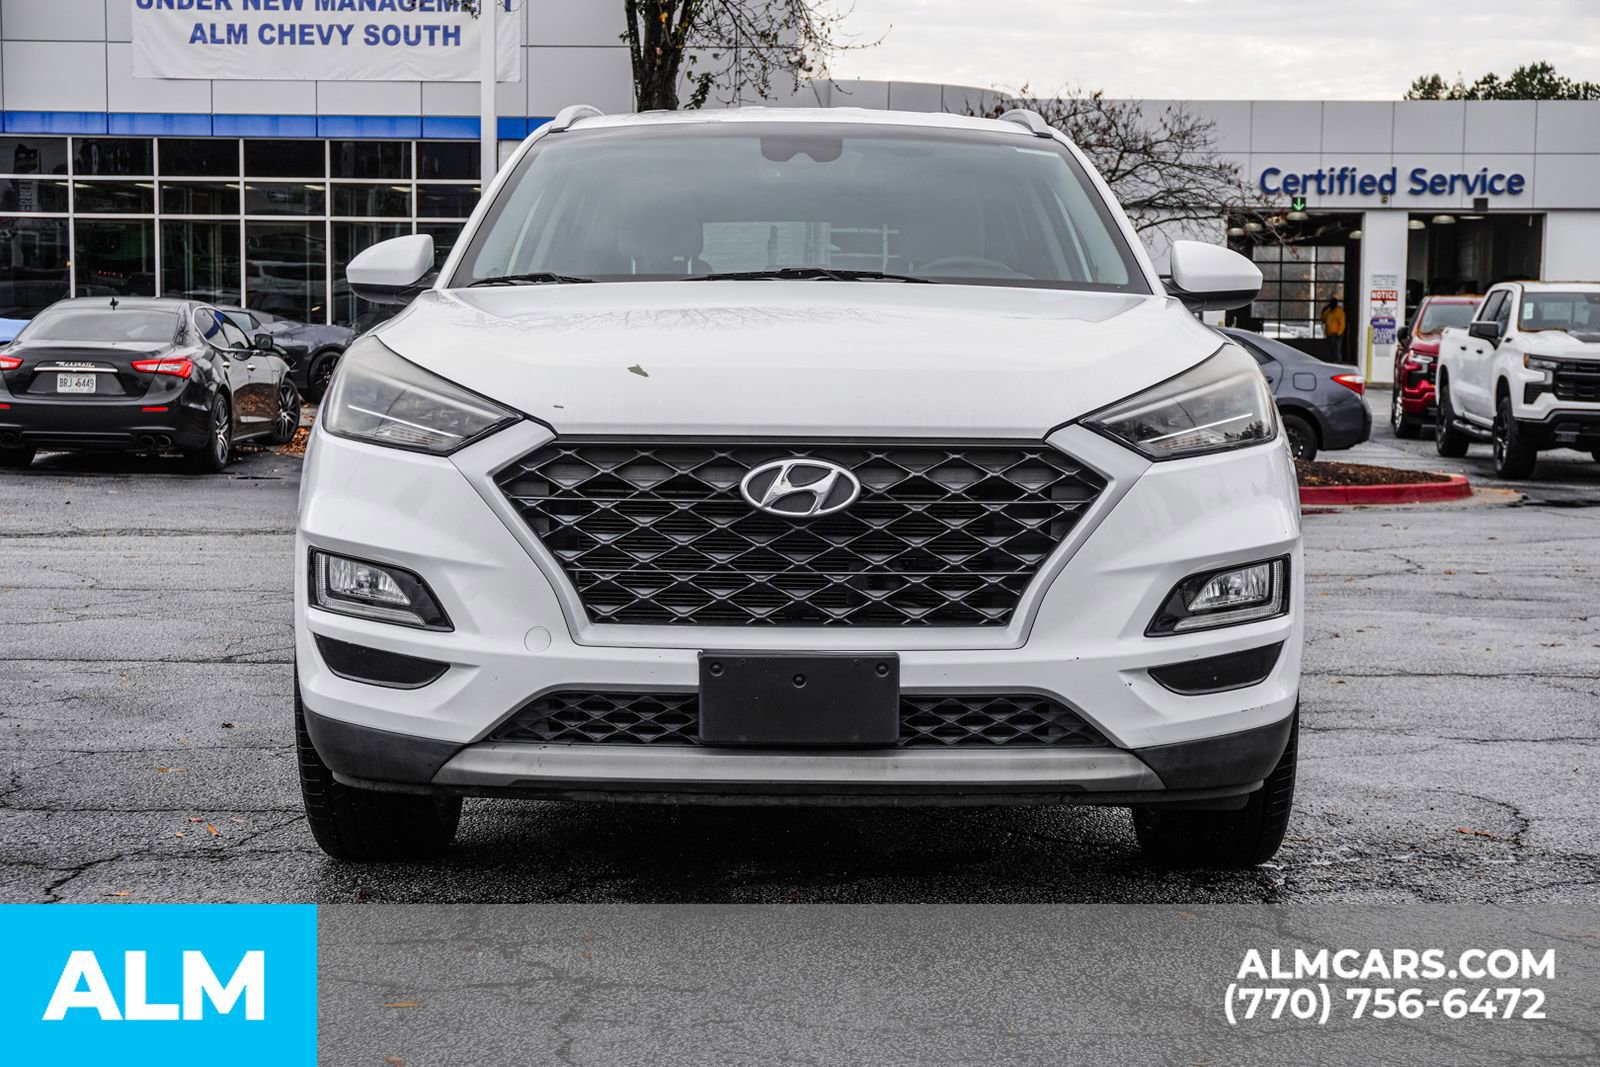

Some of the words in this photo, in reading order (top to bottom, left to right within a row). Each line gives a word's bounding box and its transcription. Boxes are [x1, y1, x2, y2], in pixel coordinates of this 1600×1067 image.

[136, 0, 233, 11] UNDER
[242, 0, 304, 11] NEW
[314, 0, 512, 12] MANAGEM
[188, 23, 248, 45] ALM
[258, 23, 355, 46] CHEVY
[363, 24, 461, 46] SOUTH
[1259, 166, 1397, 196] Certified
[1408, 167, 1526, 197] Service
[1371, 290, 1397, 300] NOTICE
[59, 377, 73, 388] BRJ
